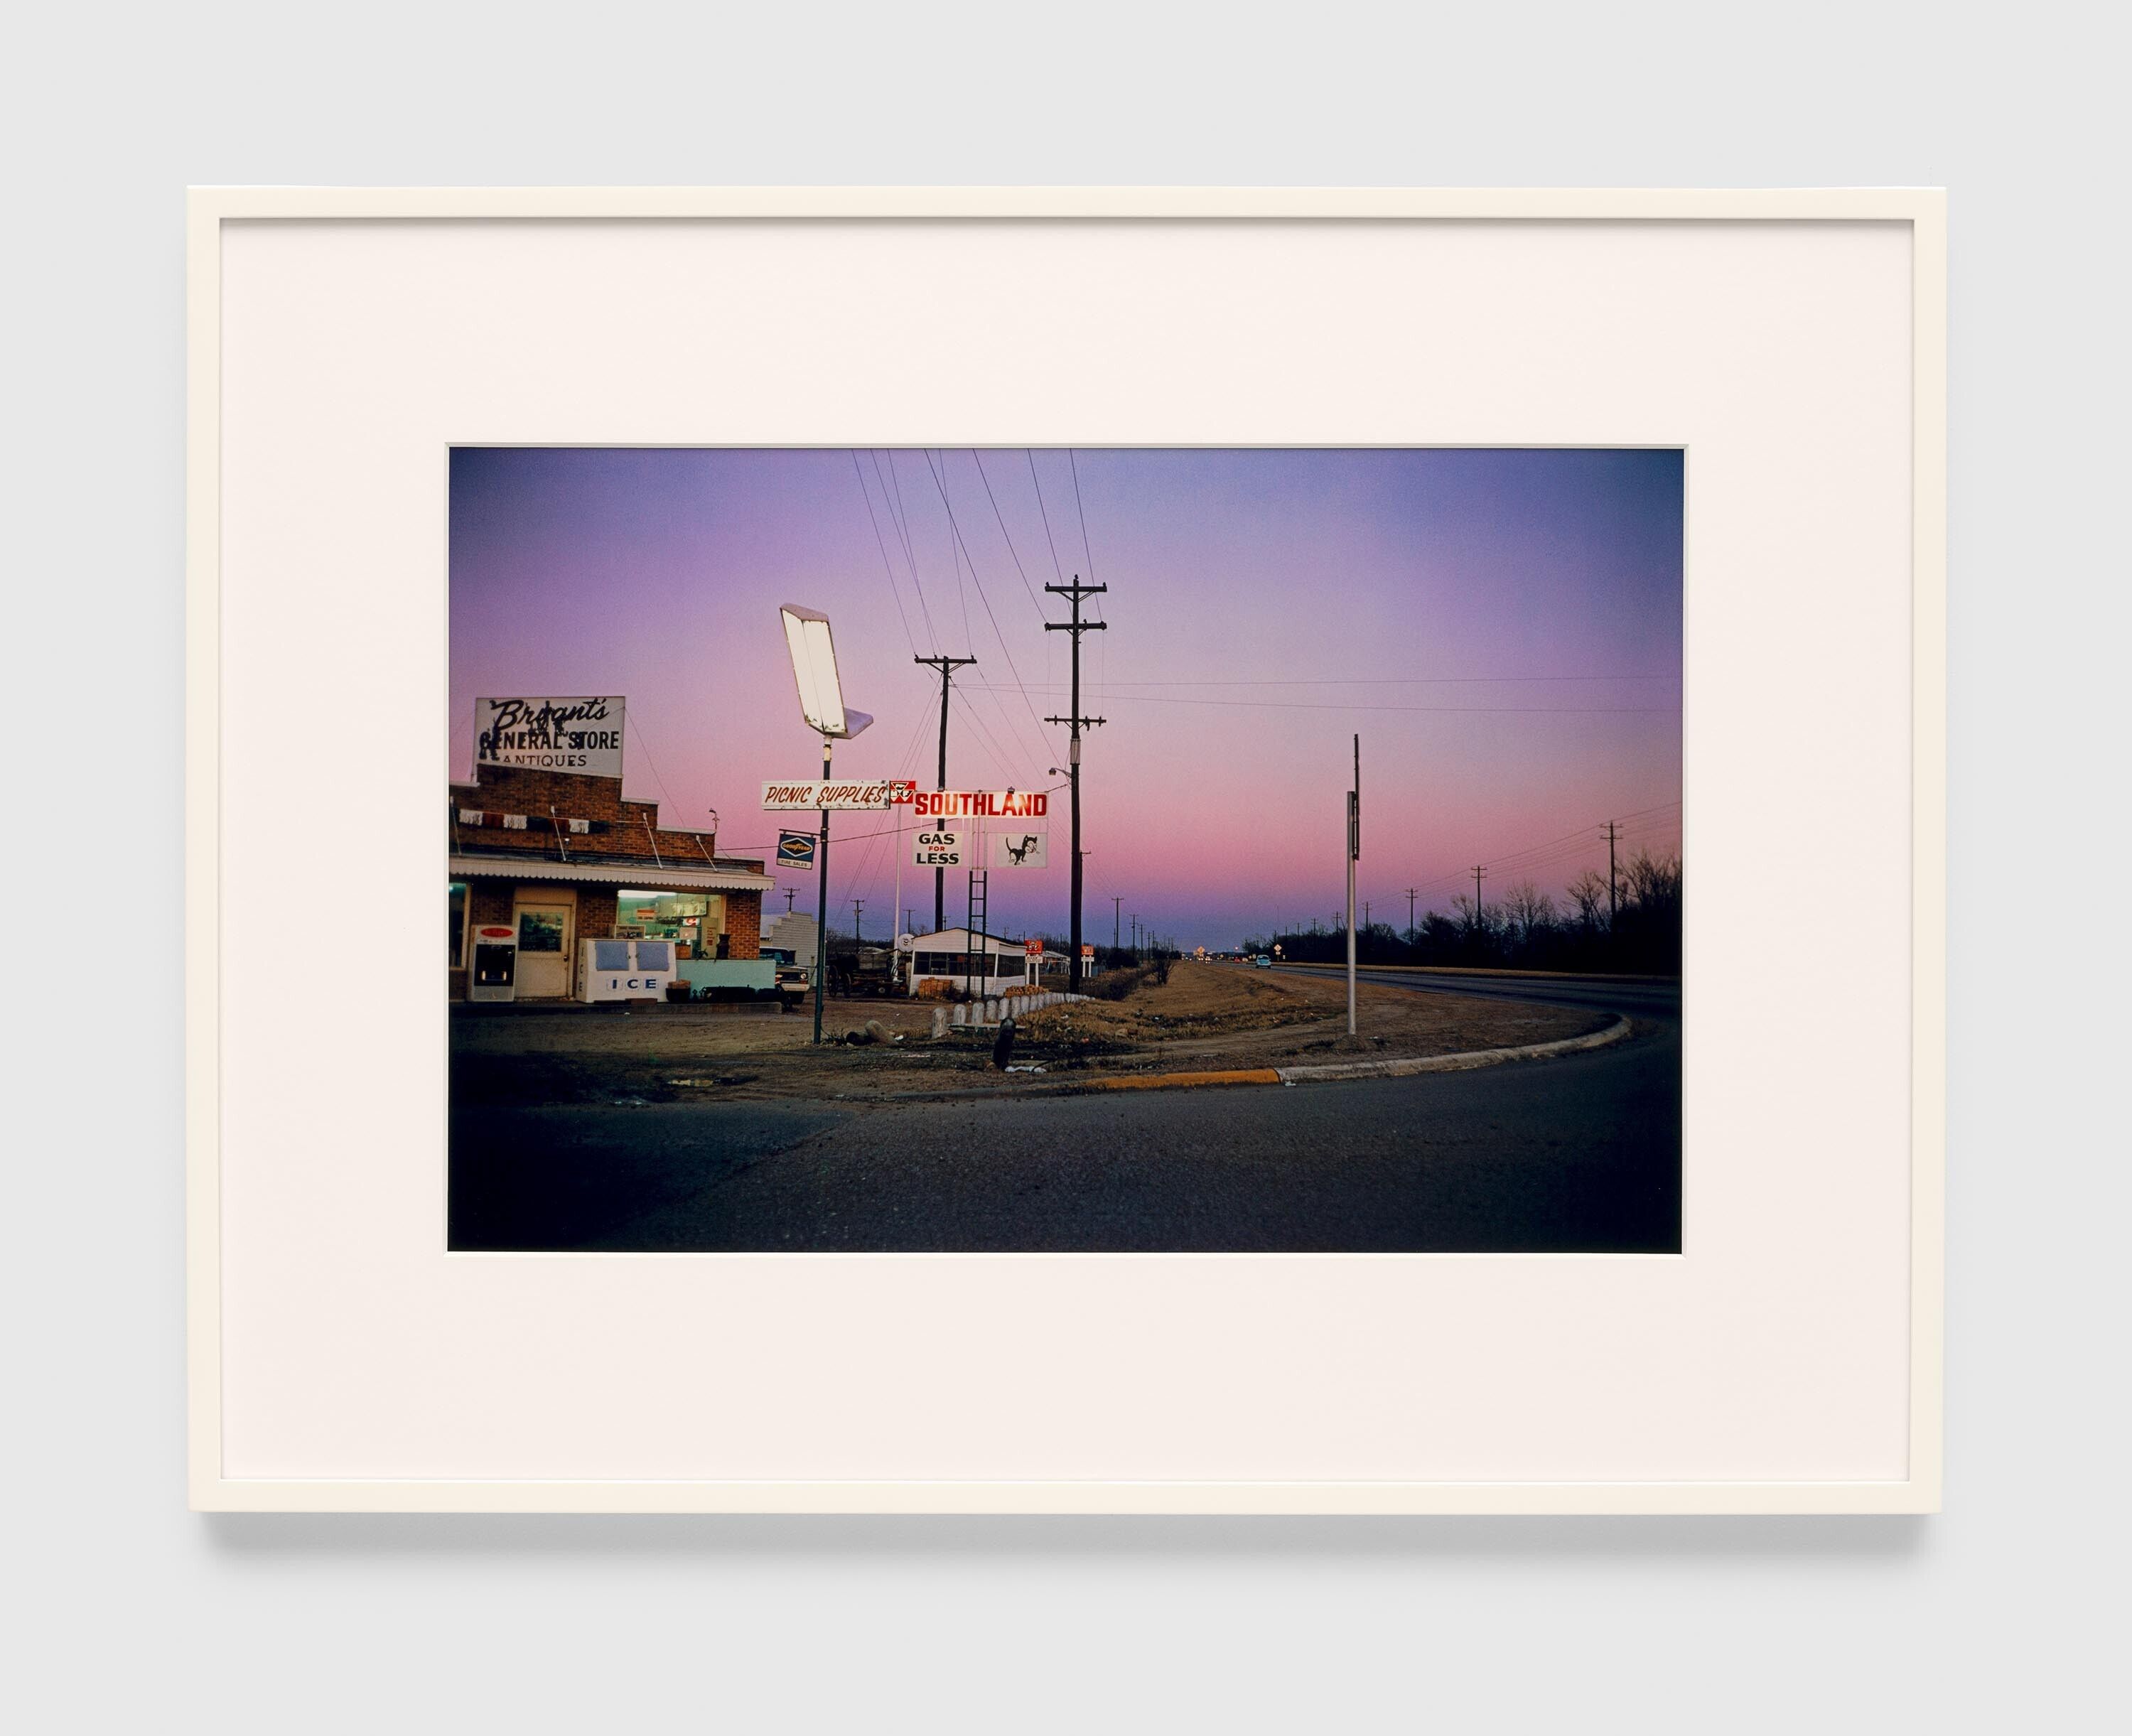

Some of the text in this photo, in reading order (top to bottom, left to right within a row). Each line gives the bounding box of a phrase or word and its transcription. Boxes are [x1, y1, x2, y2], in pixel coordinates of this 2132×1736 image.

[490, 698, 609, 730] Bryant's
[569, 730, 619, 750] STORE
[503, 755, 587, 767] ANTIQUES
[765, 786, 885, 803] PICNIC SUPPLIES
[915, 793, 1047, 816] SOUTHLAND
[918, 834, 955, 845] GAS
[916, 853, 959, 865] LESS
[612, 978, 657, 989] ICE
